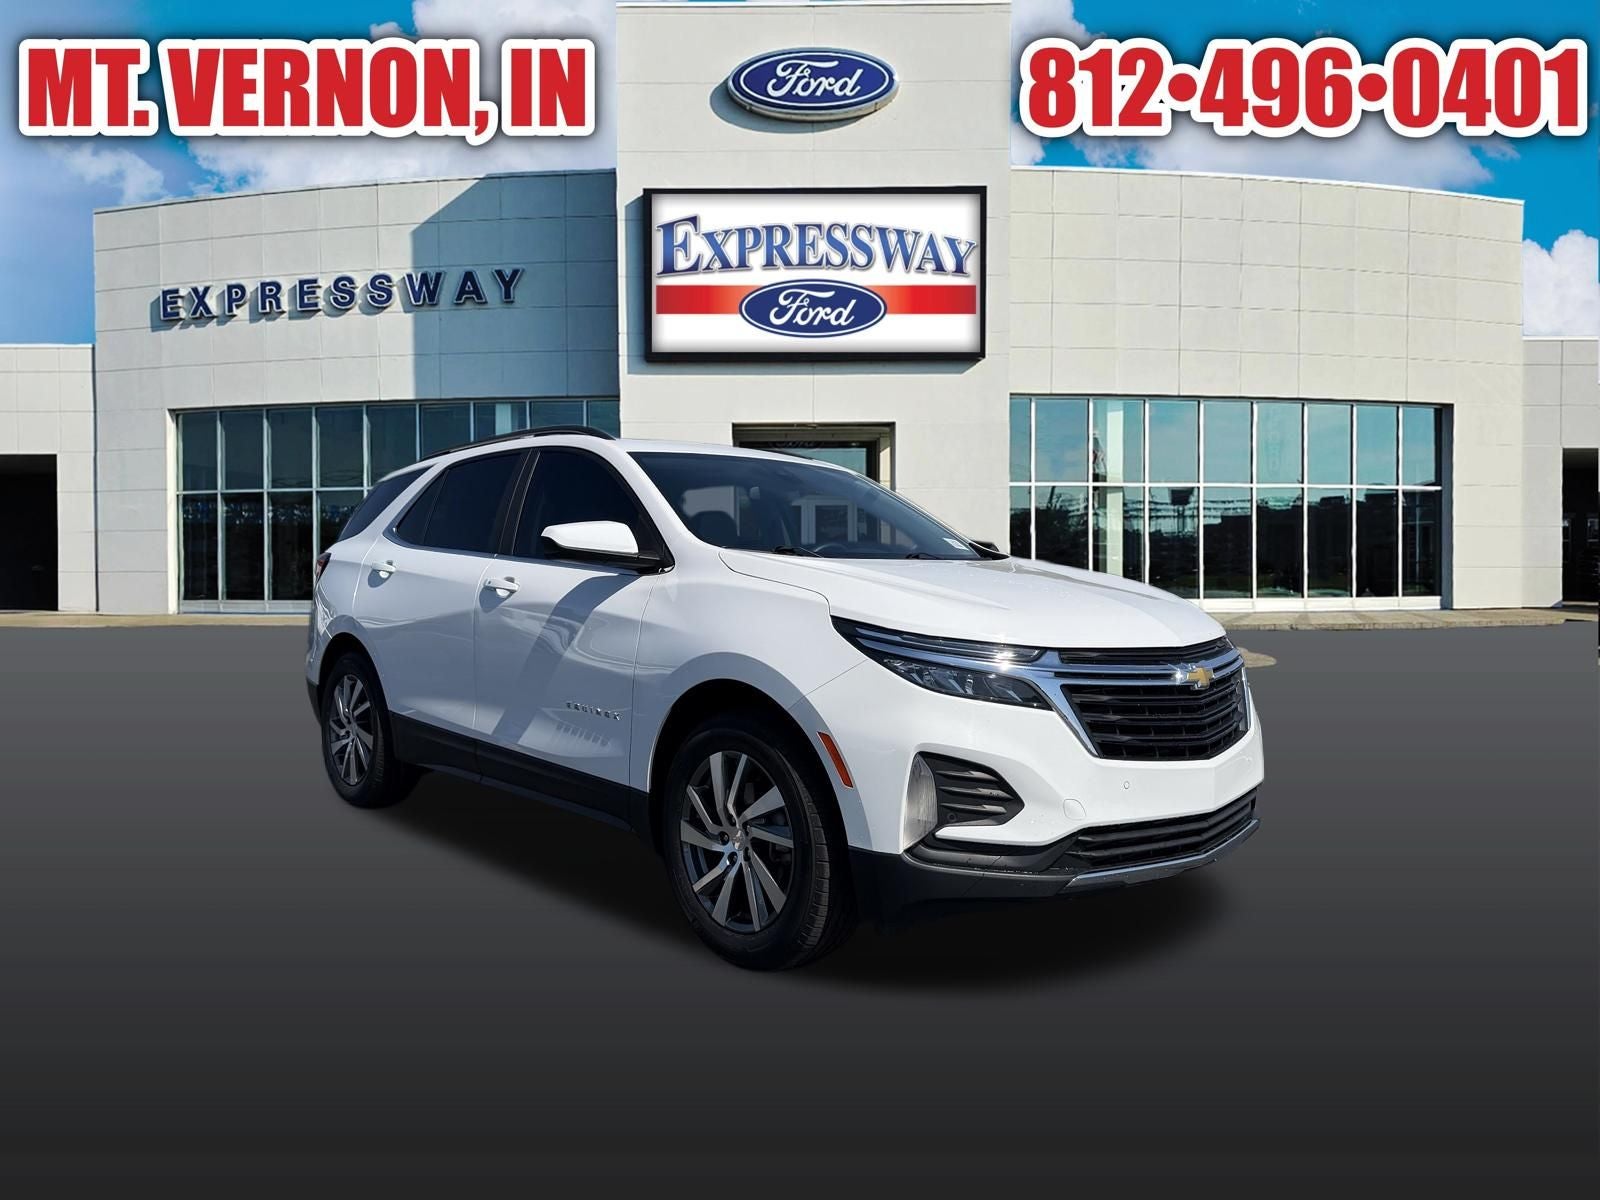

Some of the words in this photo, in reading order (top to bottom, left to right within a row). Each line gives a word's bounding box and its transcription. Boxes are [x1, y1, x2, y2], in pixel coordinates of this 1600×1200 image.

[767, 60, 863, 97] Ford
[656, 214, 977, 277] EXPRESSWAY
[159, 268, 525, 321] EXPRESSWAY
[769, 288, 857, 326] Ford
